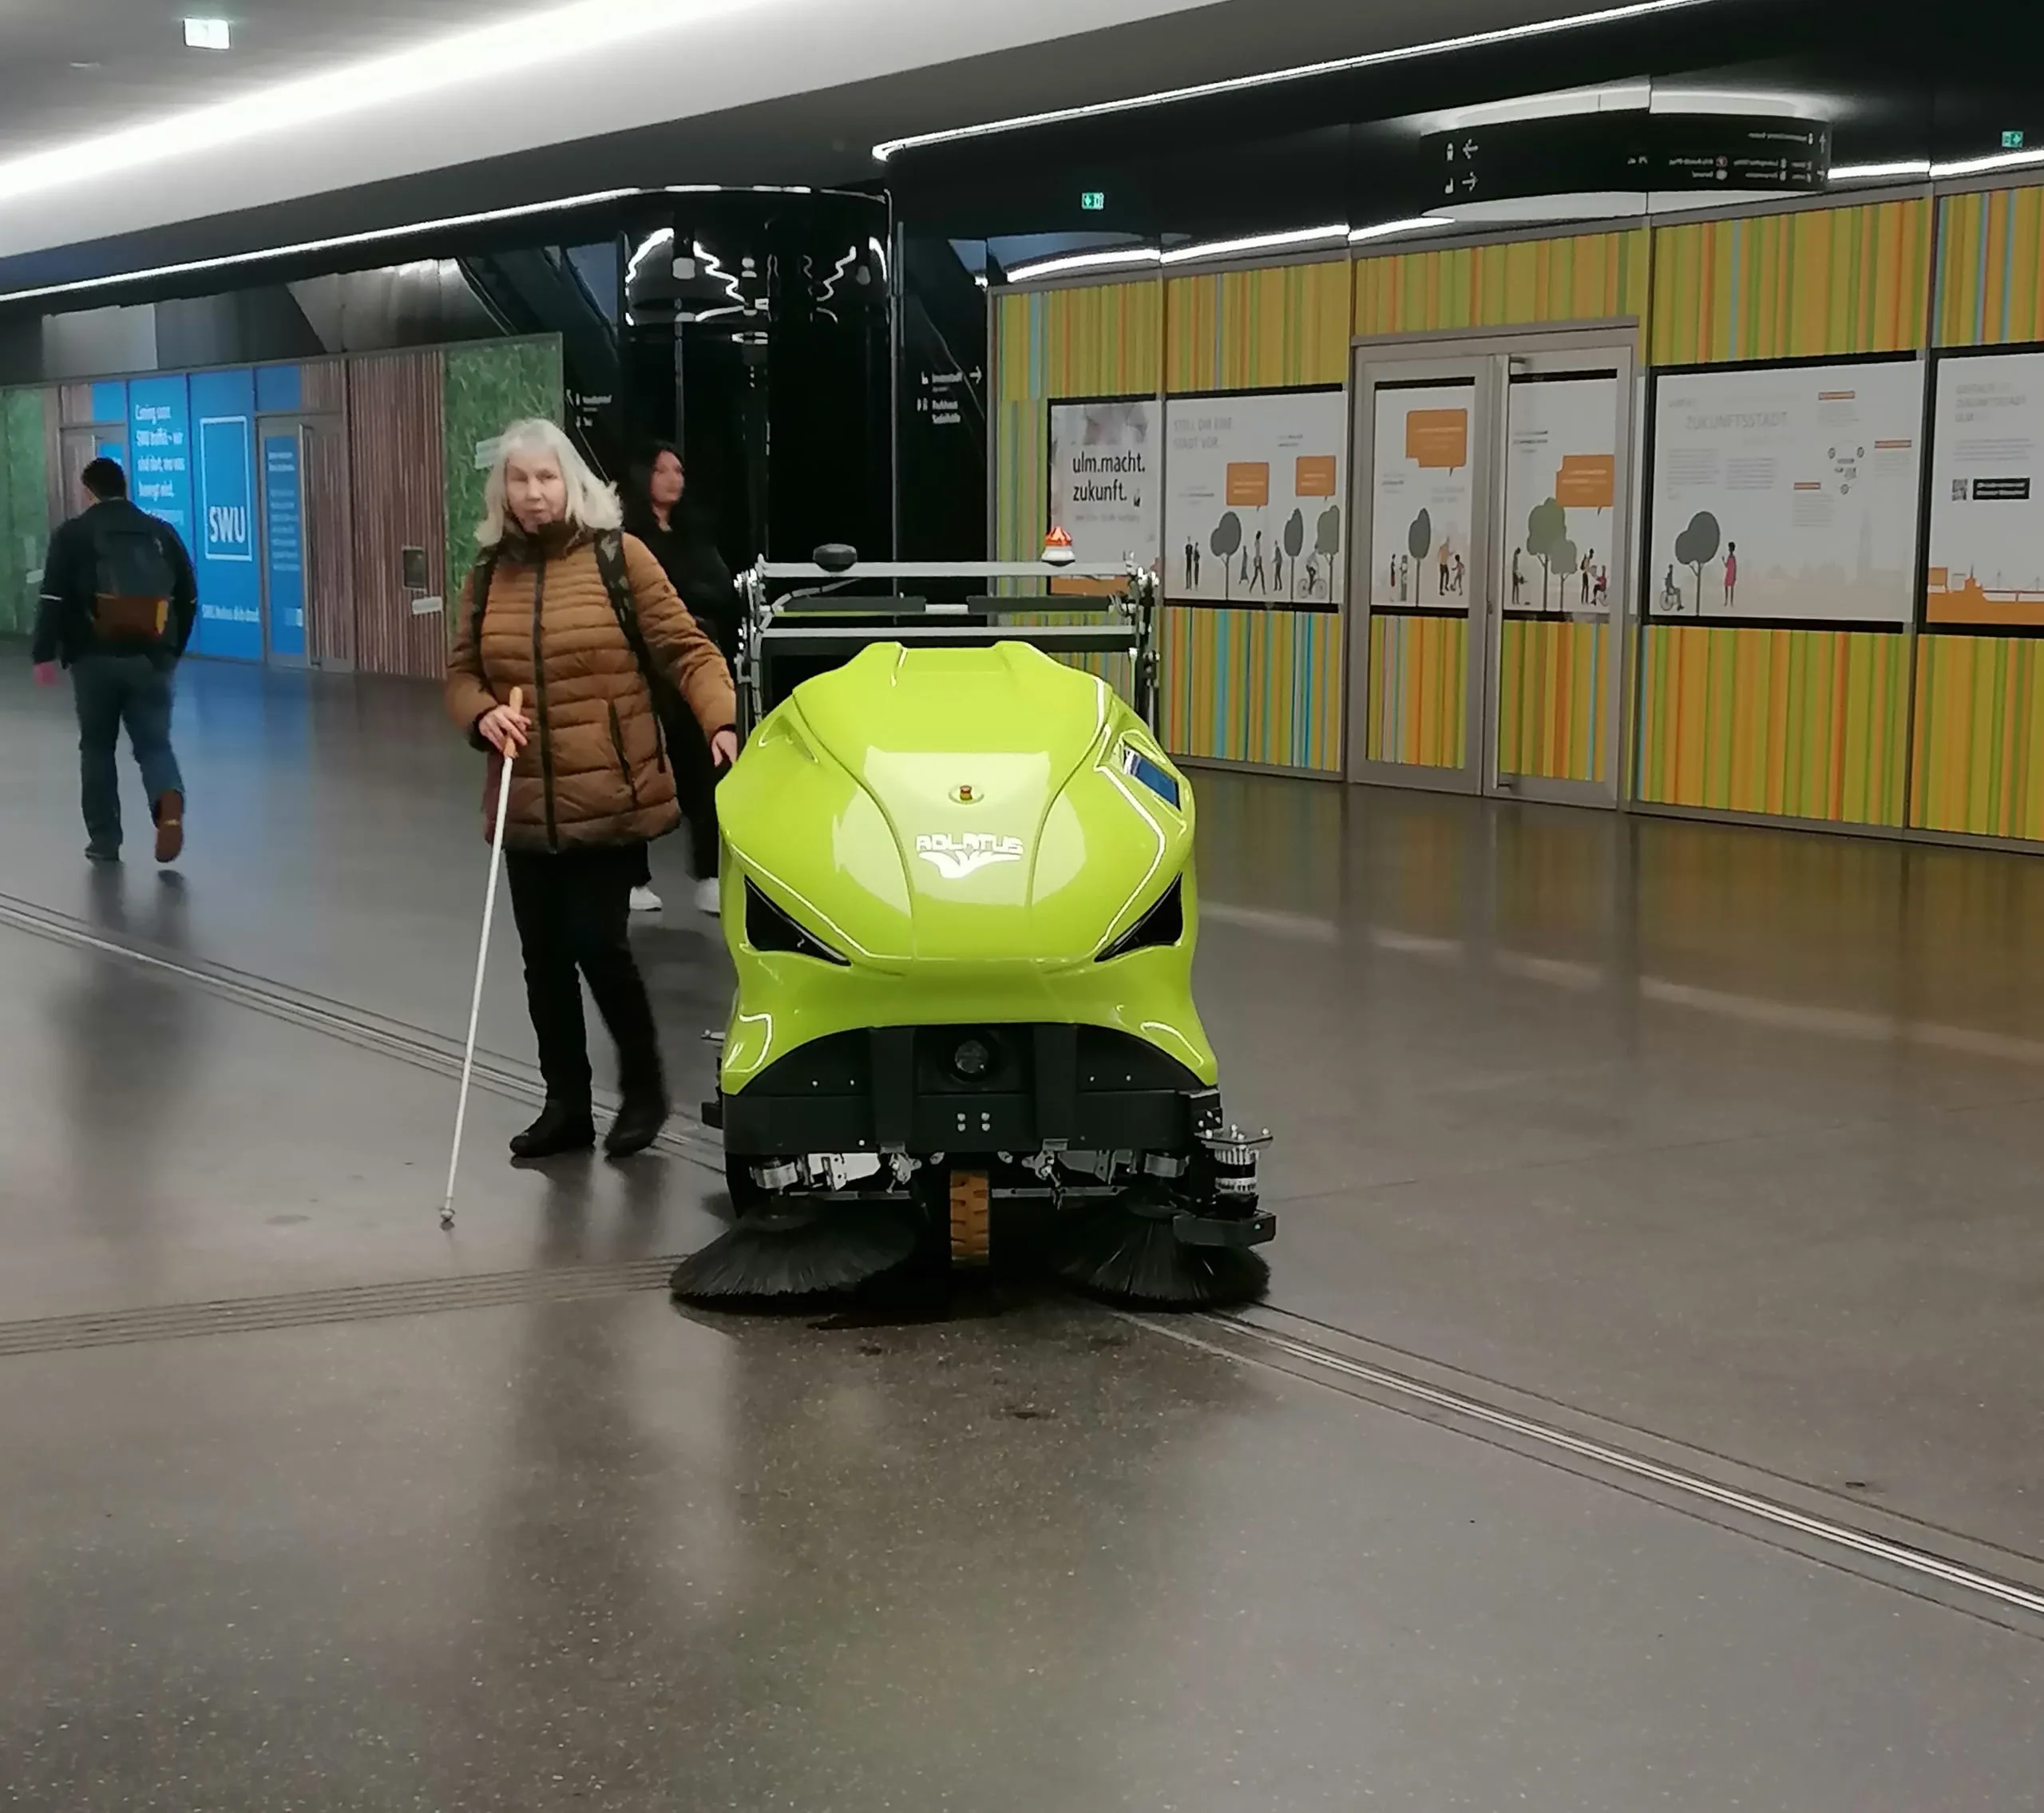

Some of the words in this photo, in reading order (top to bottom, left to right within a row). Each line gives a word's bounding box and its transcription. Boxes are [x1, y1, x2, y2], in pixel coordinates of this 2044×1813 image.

[1072, 450, 1146, 473] ulm.macht.
[1072, 478, 1127, 502] zukunft.
[209, 505, 246, 544] SWU
[916, 833, 1024, 855] ADLATUS
